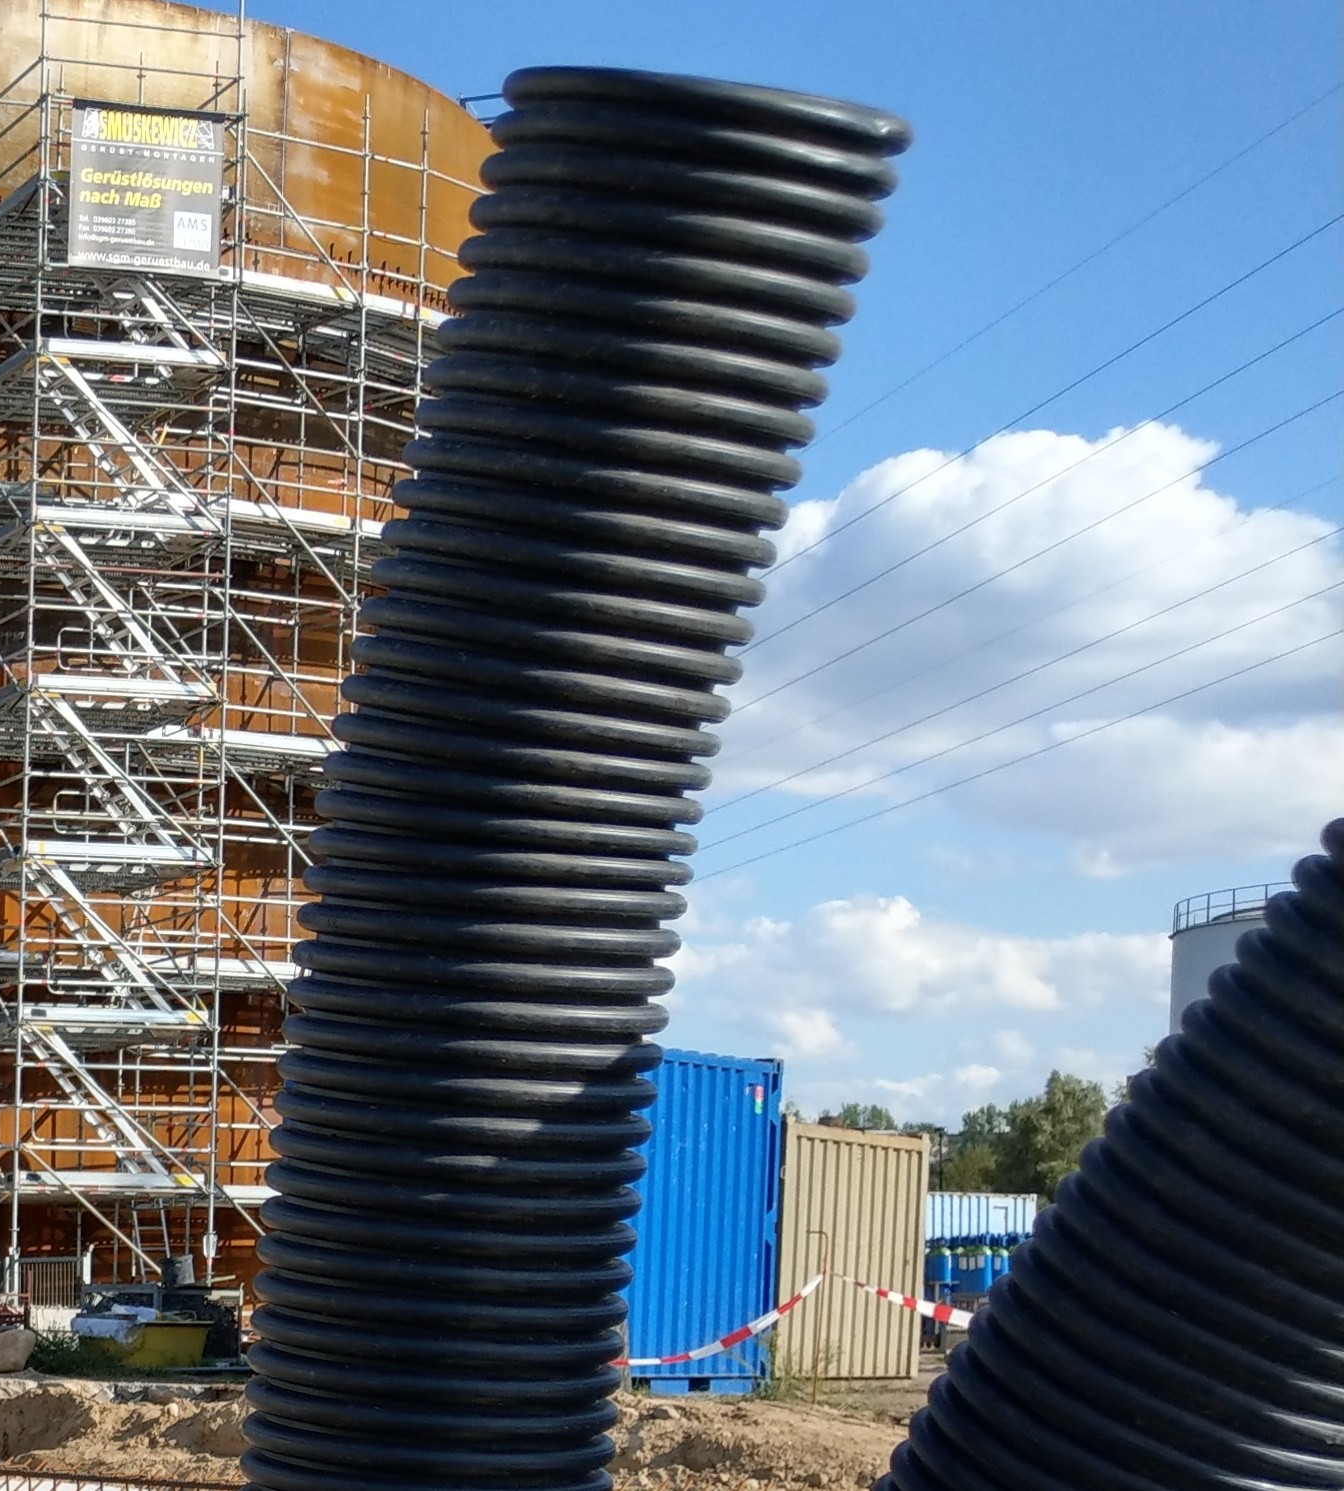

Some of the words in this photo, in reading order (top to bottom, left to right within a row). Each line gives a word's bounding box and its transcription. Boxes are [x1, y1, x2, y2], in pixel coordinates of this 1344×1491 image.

[99, 110, 197, 149] SMUSKEWICZ
[80, 168, 214, 195] Gerüstlösungen
[79, 189, 120, 205] nach
[124, 191, 162, 209] Maß
[177, 216, 208, 231] AMS
[77, 249, 211, 272] www.sgm-geruestbau.de
